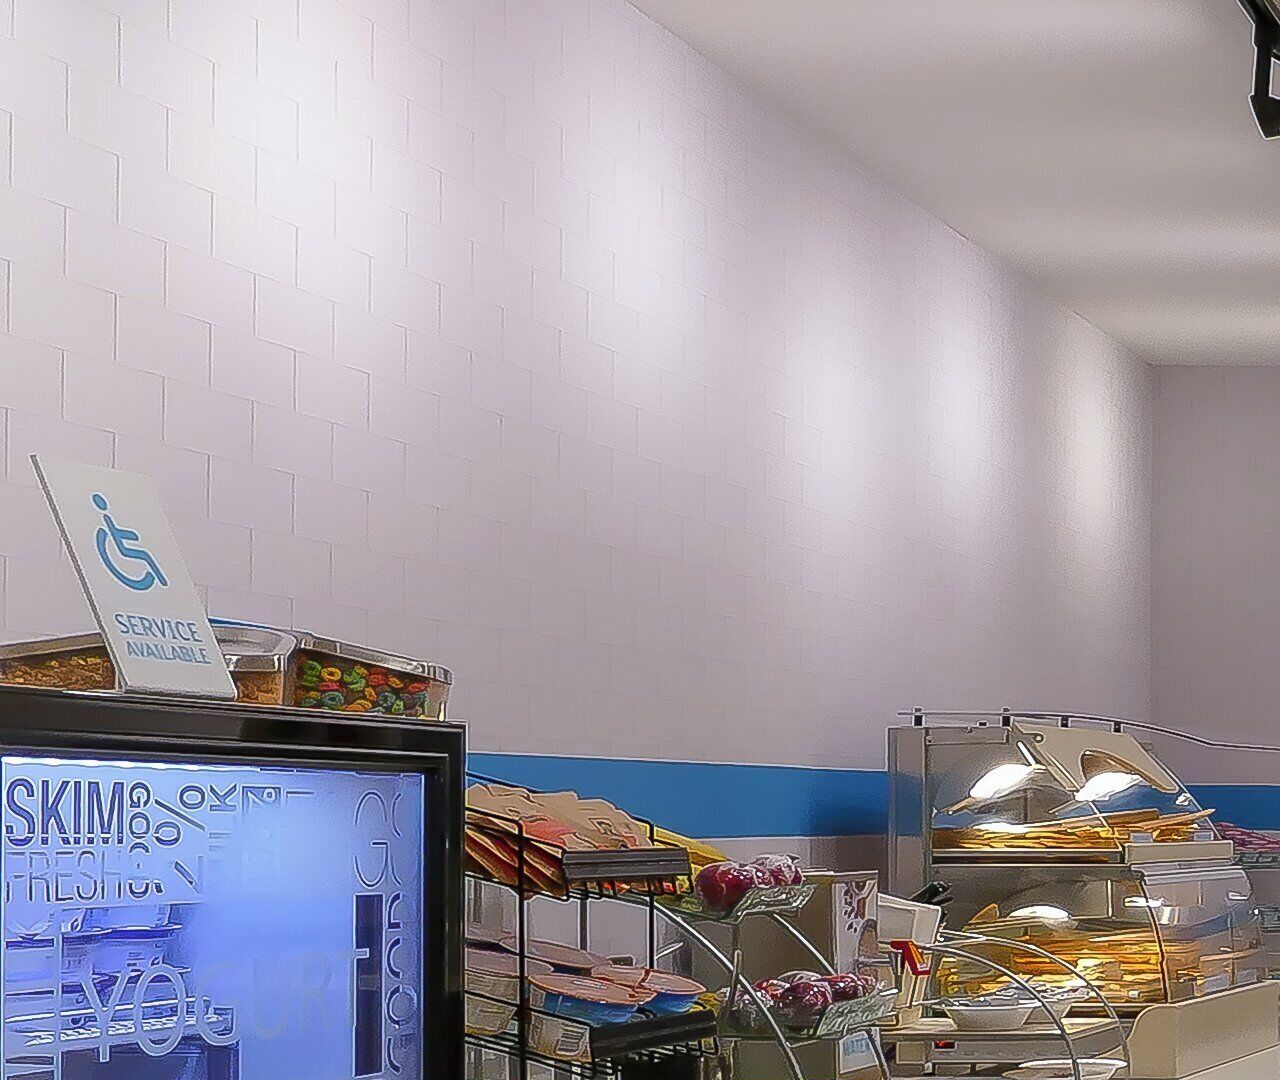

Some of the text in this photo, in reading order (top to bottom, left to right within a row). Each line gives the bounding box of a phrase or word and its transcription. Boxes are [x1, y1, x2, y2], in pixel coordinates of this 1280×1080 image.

[114, 613, 203, 643] SERVICE
[126, 640, 212, 665] AVAILABLE
[5, 777, 125, 847] SKIM
